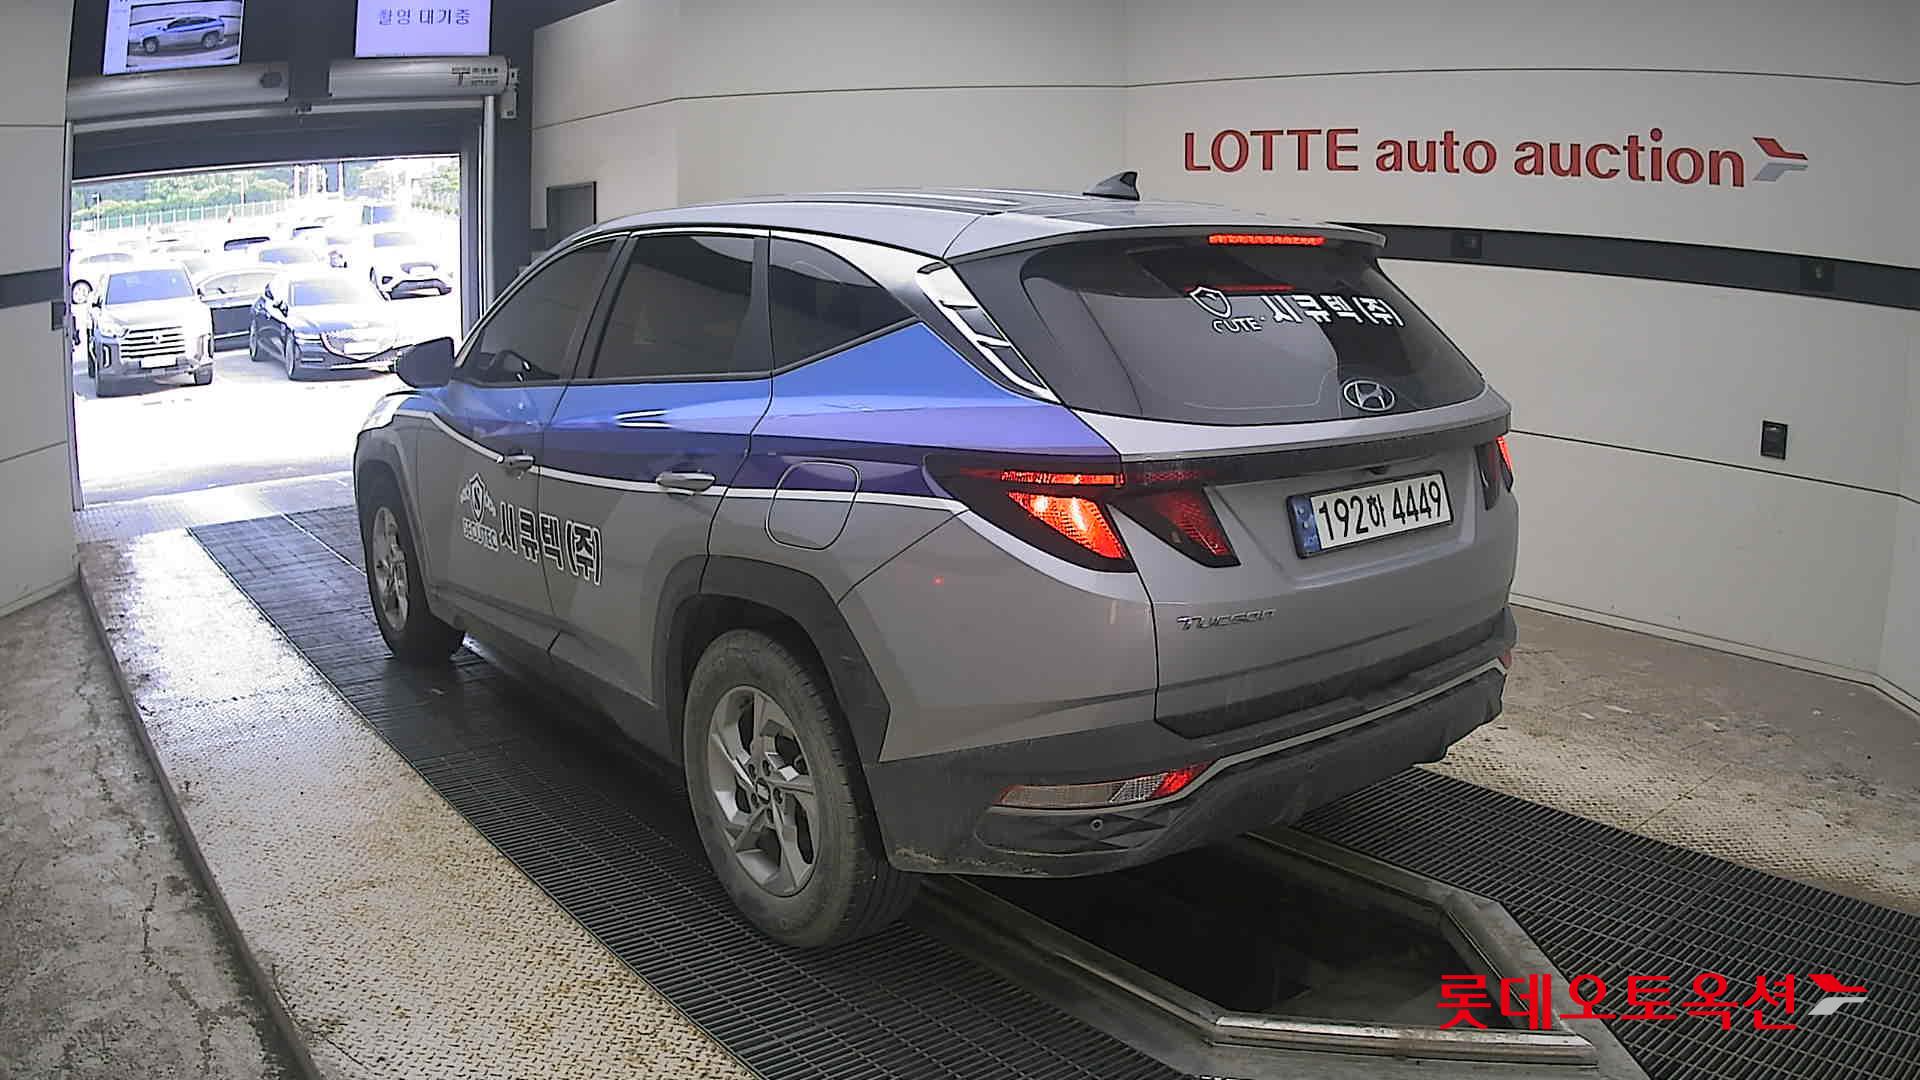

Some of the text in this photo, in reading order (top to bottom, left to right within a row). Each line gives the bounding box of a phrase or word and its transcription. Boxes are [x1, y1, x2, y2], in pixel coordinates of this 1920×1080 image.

[419, 8, 471, 25] 대기중
[1184, 127, 1744, 187] LOTTE auto auction
[1393, 481, 1442, 525] 4449
